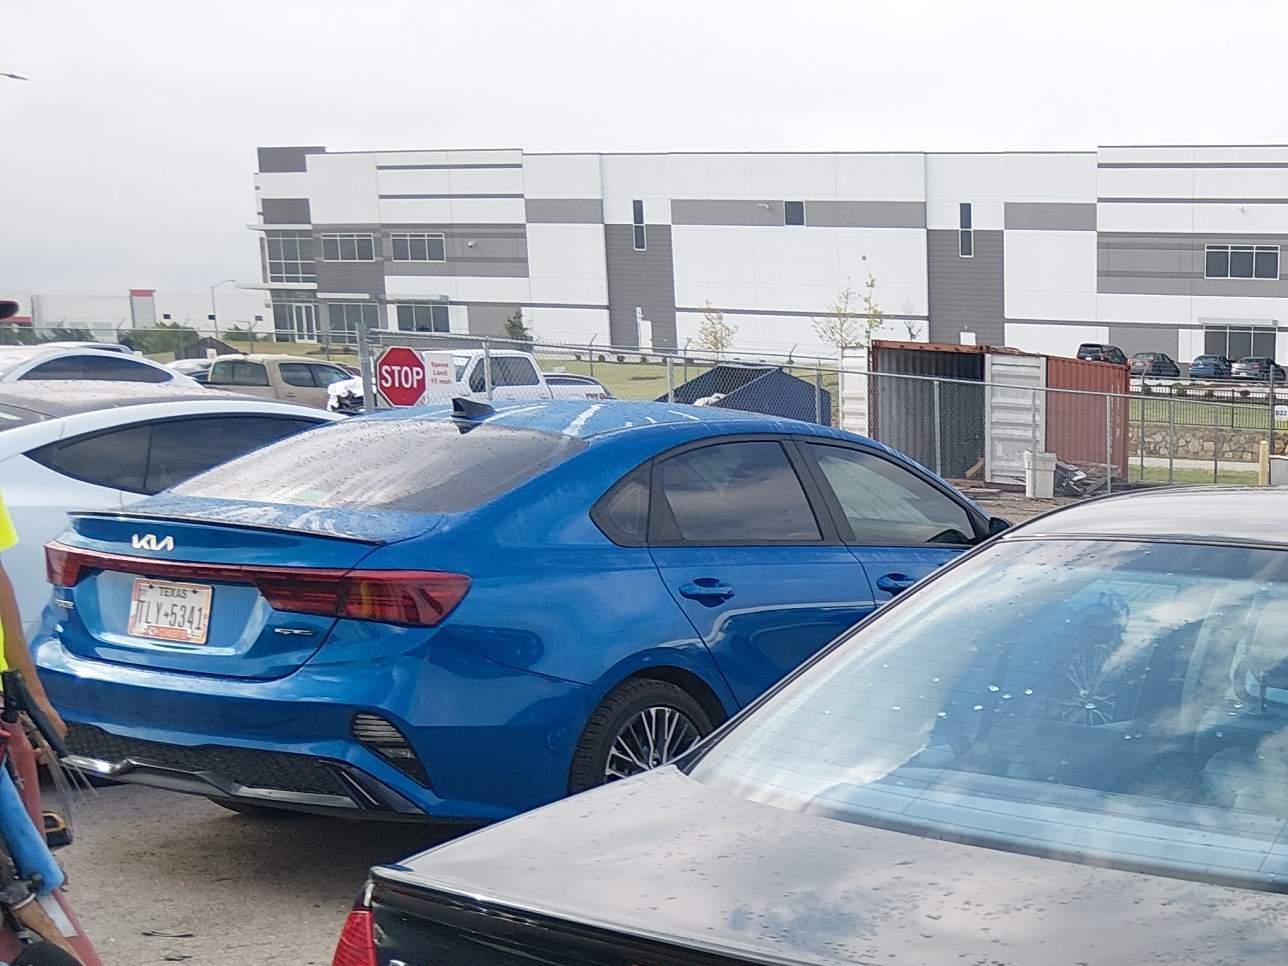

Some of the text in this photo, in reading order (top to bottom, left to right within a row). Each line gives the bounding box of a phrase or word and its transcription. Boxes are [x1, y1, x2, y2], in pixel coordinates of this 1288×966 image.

[381, 365, 423, 388] STOP
[131, 534, 174, 551] KIA
[159, 587, 187, 599] TEXAS
